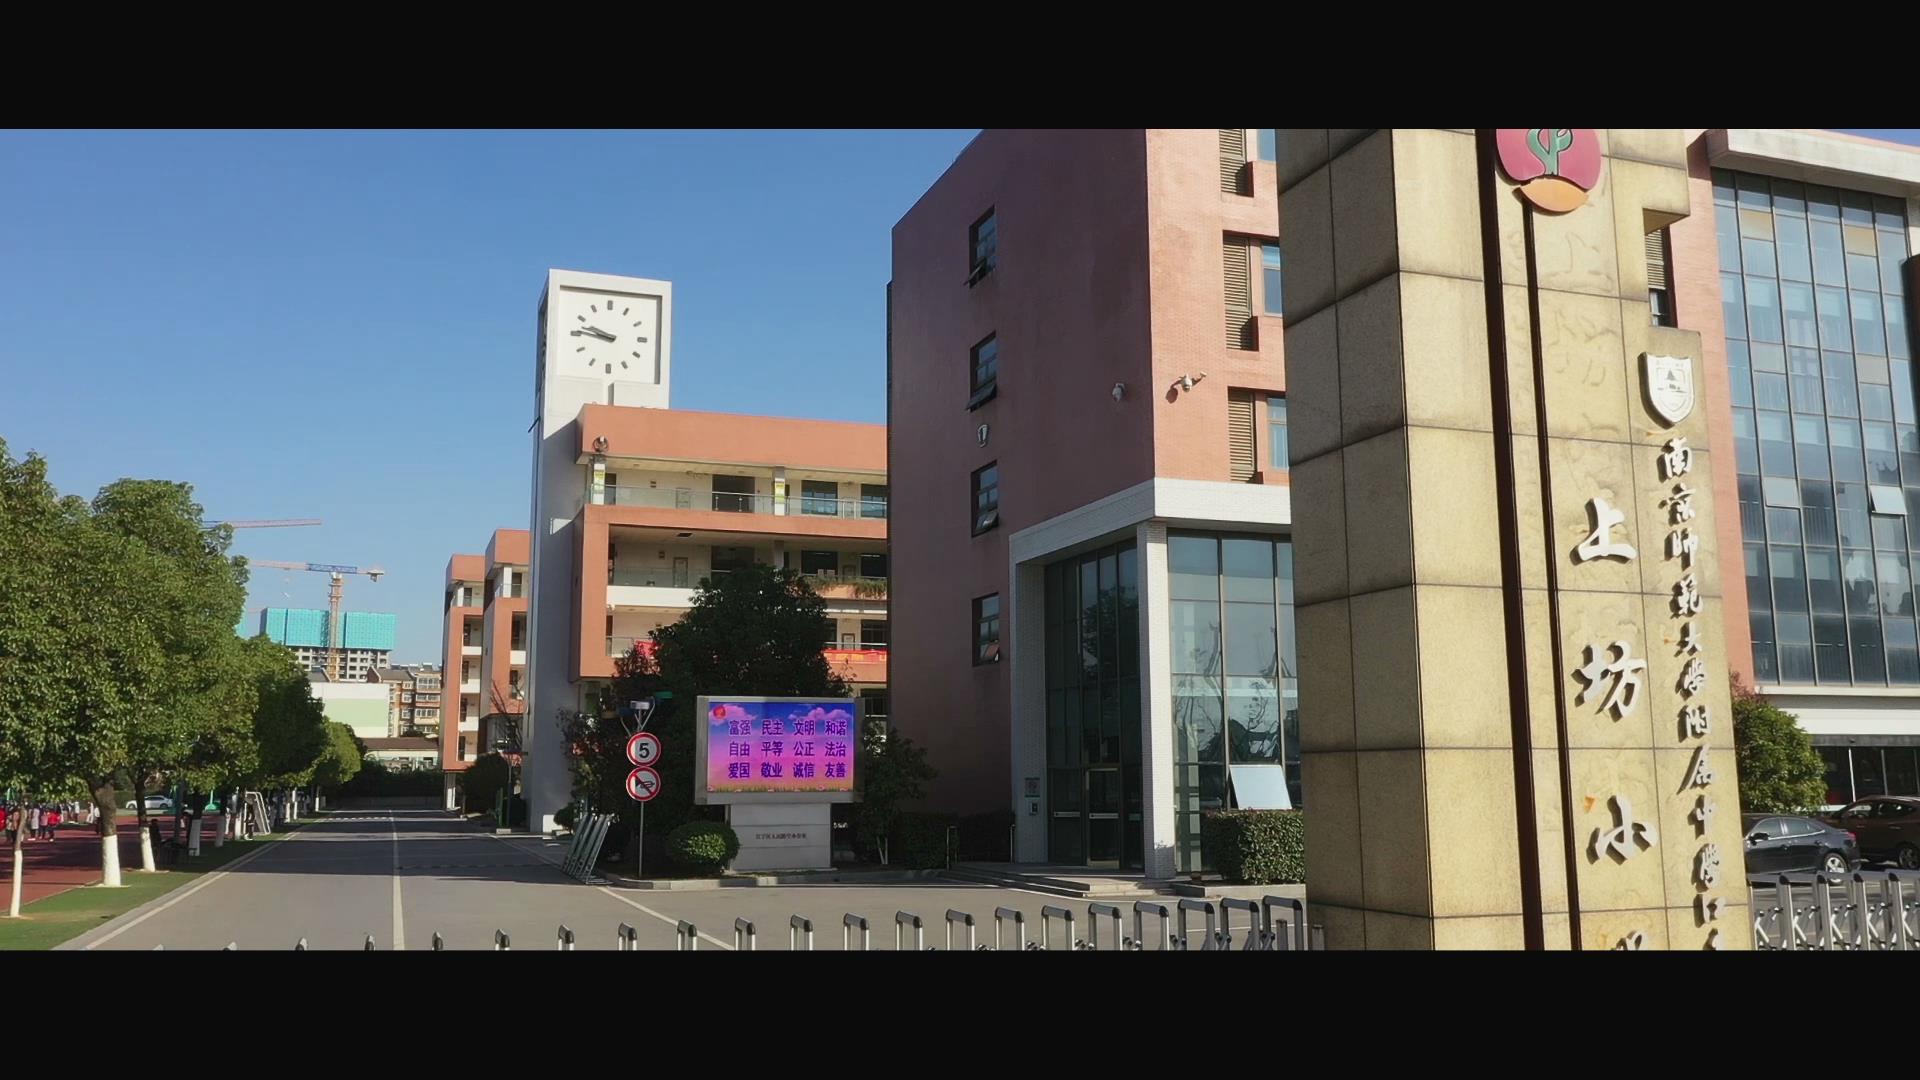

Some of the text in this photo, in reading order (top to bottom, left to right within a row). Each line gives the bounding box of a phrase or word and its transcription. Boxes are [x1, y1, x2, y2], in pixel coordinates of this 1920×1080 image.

[729, 719, 847, 736] 富强 民主 文明 和谐
[638, 742, 651, 759] 5
[729, 740, 846, 757] 自由 平等 公正 法治
[728, 761, 846, 779] 爱国 敬业 诚信 友善
